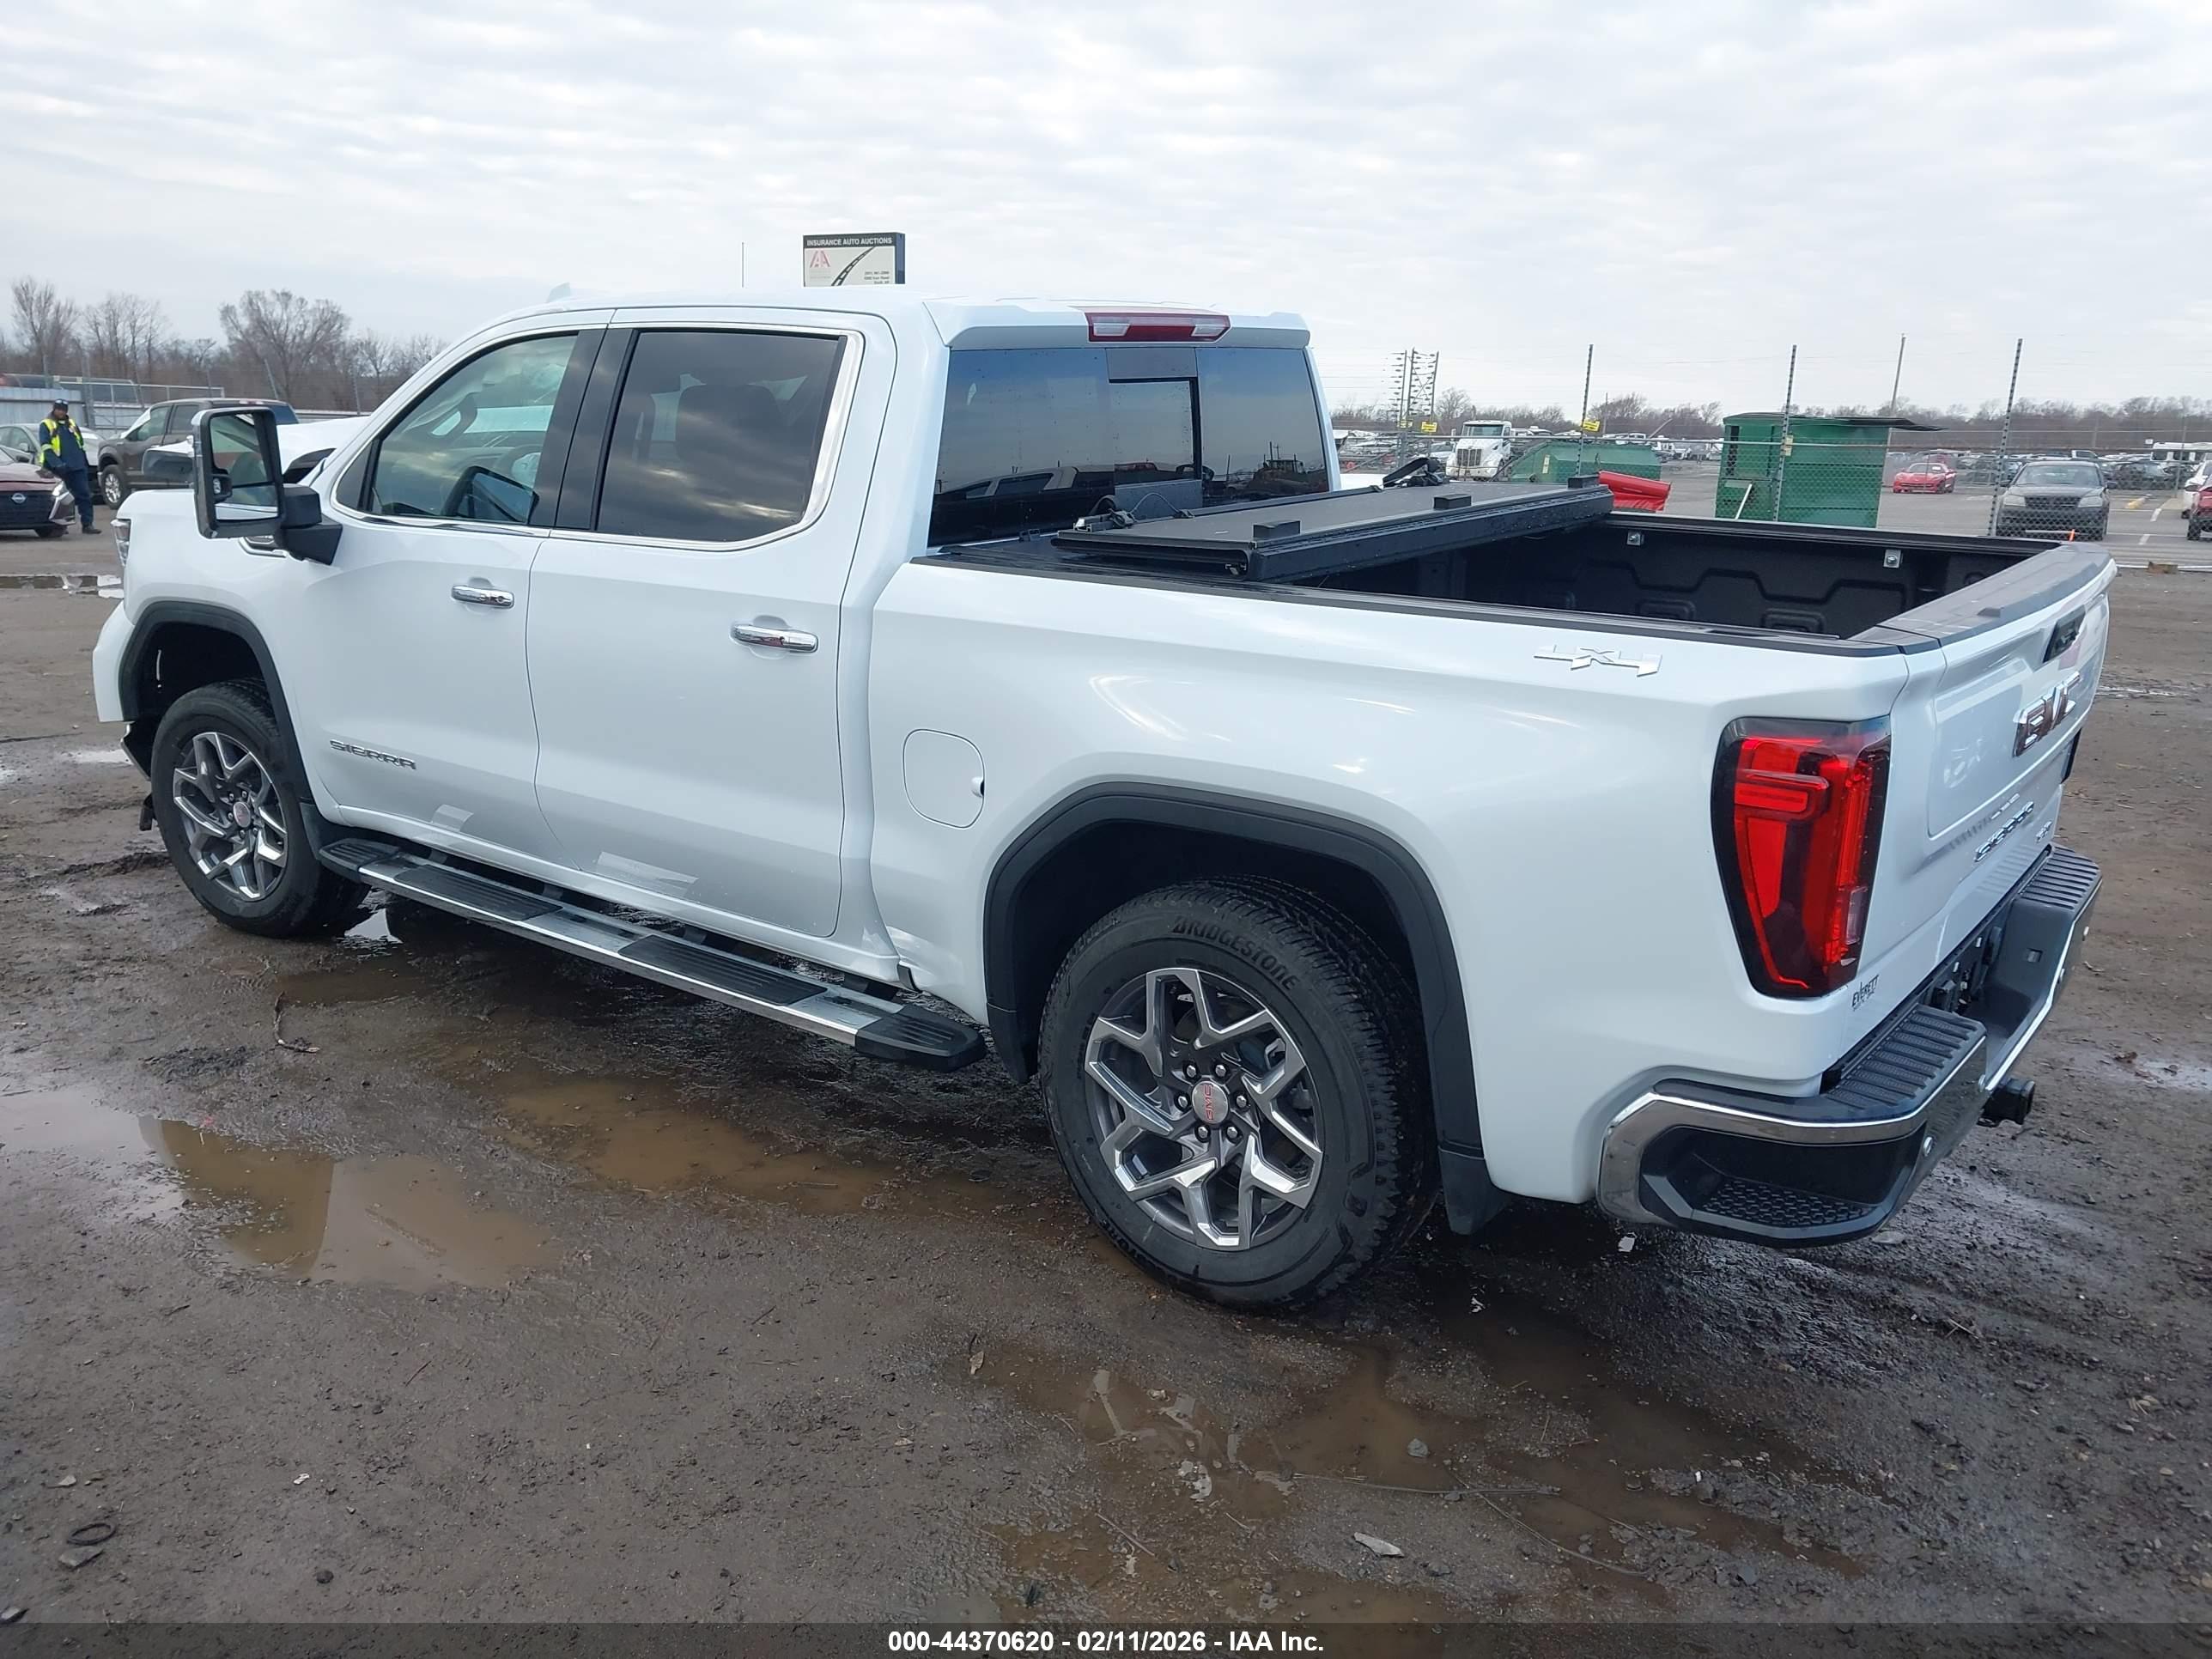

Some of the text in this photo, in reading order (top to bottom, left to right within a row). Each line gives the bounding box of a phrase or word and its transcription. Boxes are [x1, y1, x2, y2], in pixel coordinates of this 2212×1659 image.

[330, 738, 417, 770] SIERRA
[1172, 917, 1299, 990] BRIDGESTONE
[1204, 1085, 1214, 1121] GMC
